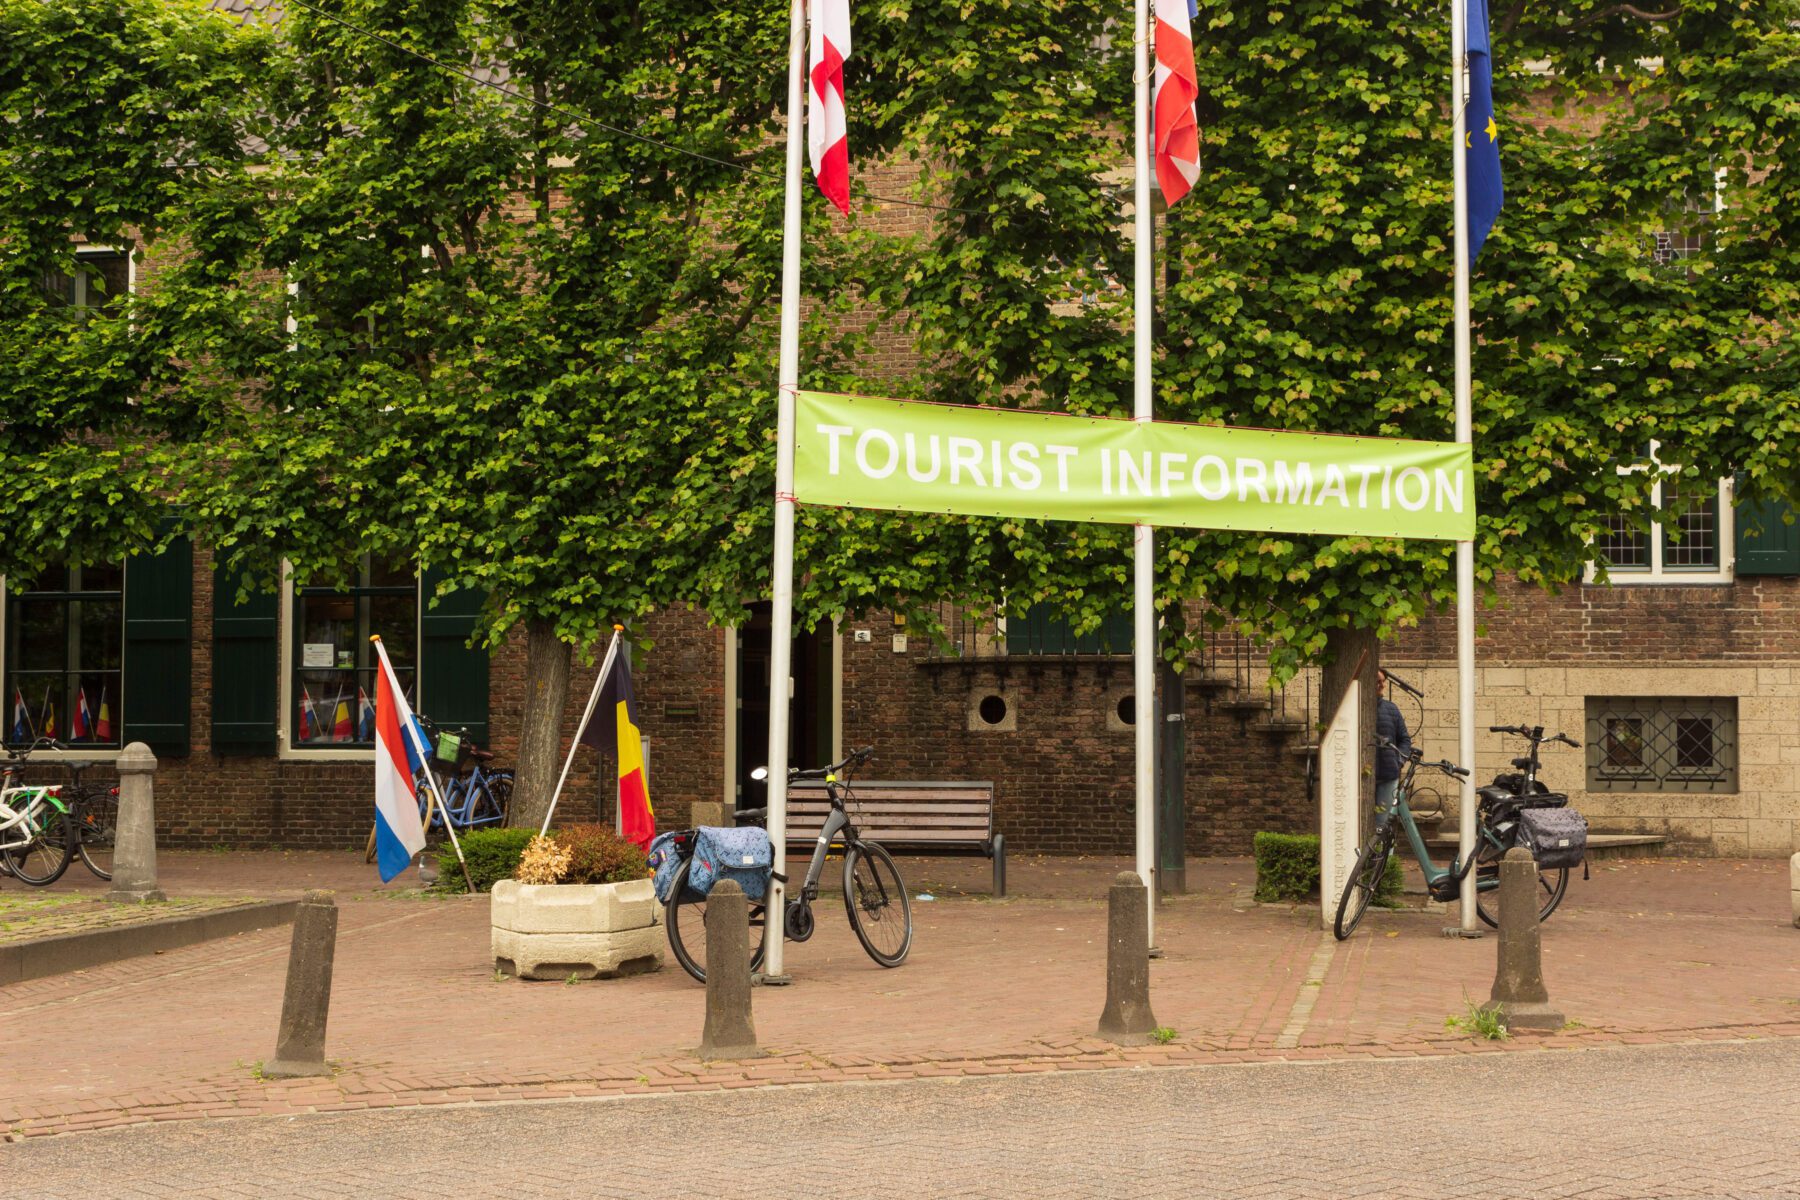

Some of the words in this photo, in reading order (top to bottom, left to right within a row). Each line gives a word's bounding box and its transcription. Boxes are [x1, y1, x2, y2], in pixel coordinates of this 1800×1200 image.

[816, 424, 1078, 492] TOURIST
[1100, 448, 1464, 513] INFORMATION
[1334, 735, 1346, 816] Liberation
[1334, 820, 1346, 863] Route
[1332, 865, 1346, 910] Europ
